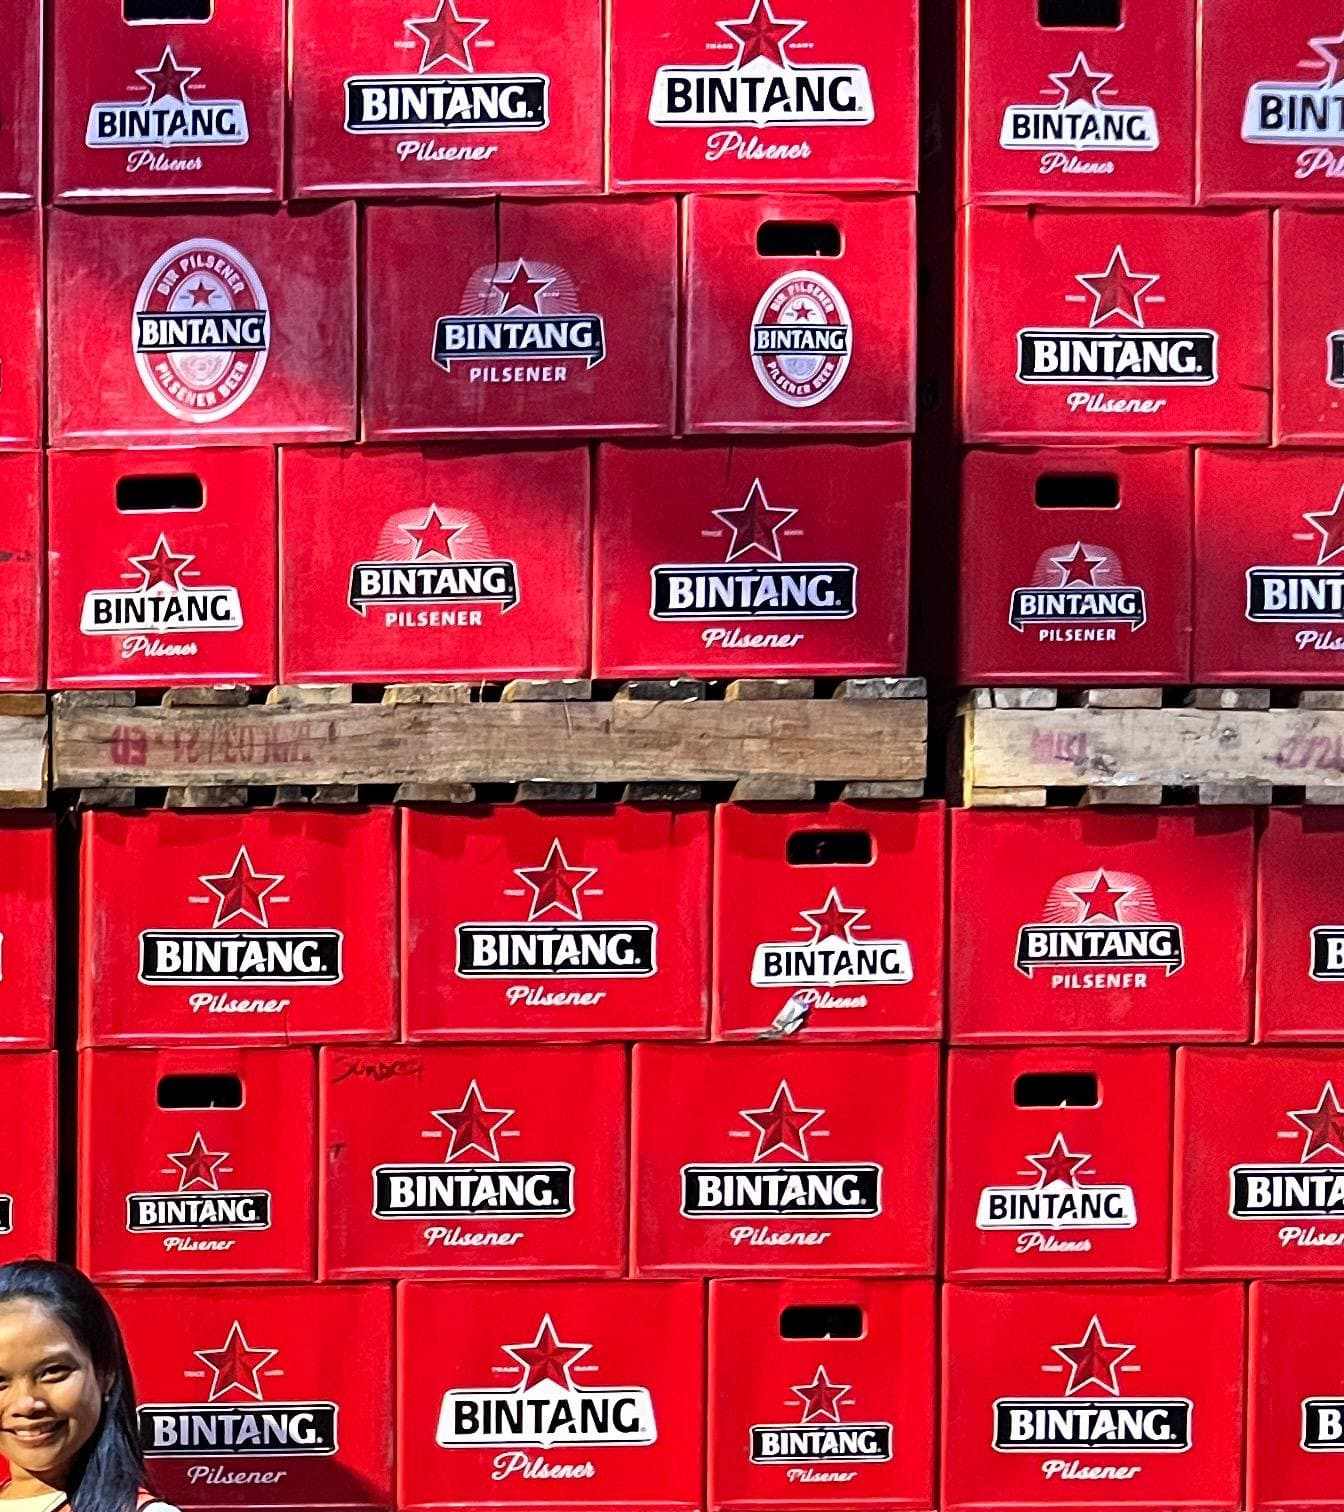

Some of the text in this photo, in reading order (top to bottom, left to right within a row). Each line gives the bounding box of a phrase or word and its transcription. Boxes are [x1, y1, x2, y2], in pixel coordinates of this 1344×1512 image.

[666, 76, 857, 113] BINTANG
[126, 148, 204, 170] Pilsener
[396, 139, 499, 161] Pilsener
[157, 254, 245, 296] BIR PILSENER
[142, 318, 261, 345] BINTANG
[757, 329, 844, 350] BINTANG
[155, 360, 248, 407] PILSENER BEER
[471, 365, 569, 382] PILSENER
[386, 610, 482, 626] PILSENER
[121, 634, 199, 656] Pilsener
[703, 627, 805, 649] Pilsener
[1039, 628, 1117, 641] PILSENER
[1053, 973, 1149, 989] PILSENER
[190, 992, 292, 1014] Pilsener
[424, 1225, 524, 1247] Pilsener
[454, 1399, 641, 1435] BINTANG
[1043, 1459, 1143, 1481] Pilsener
